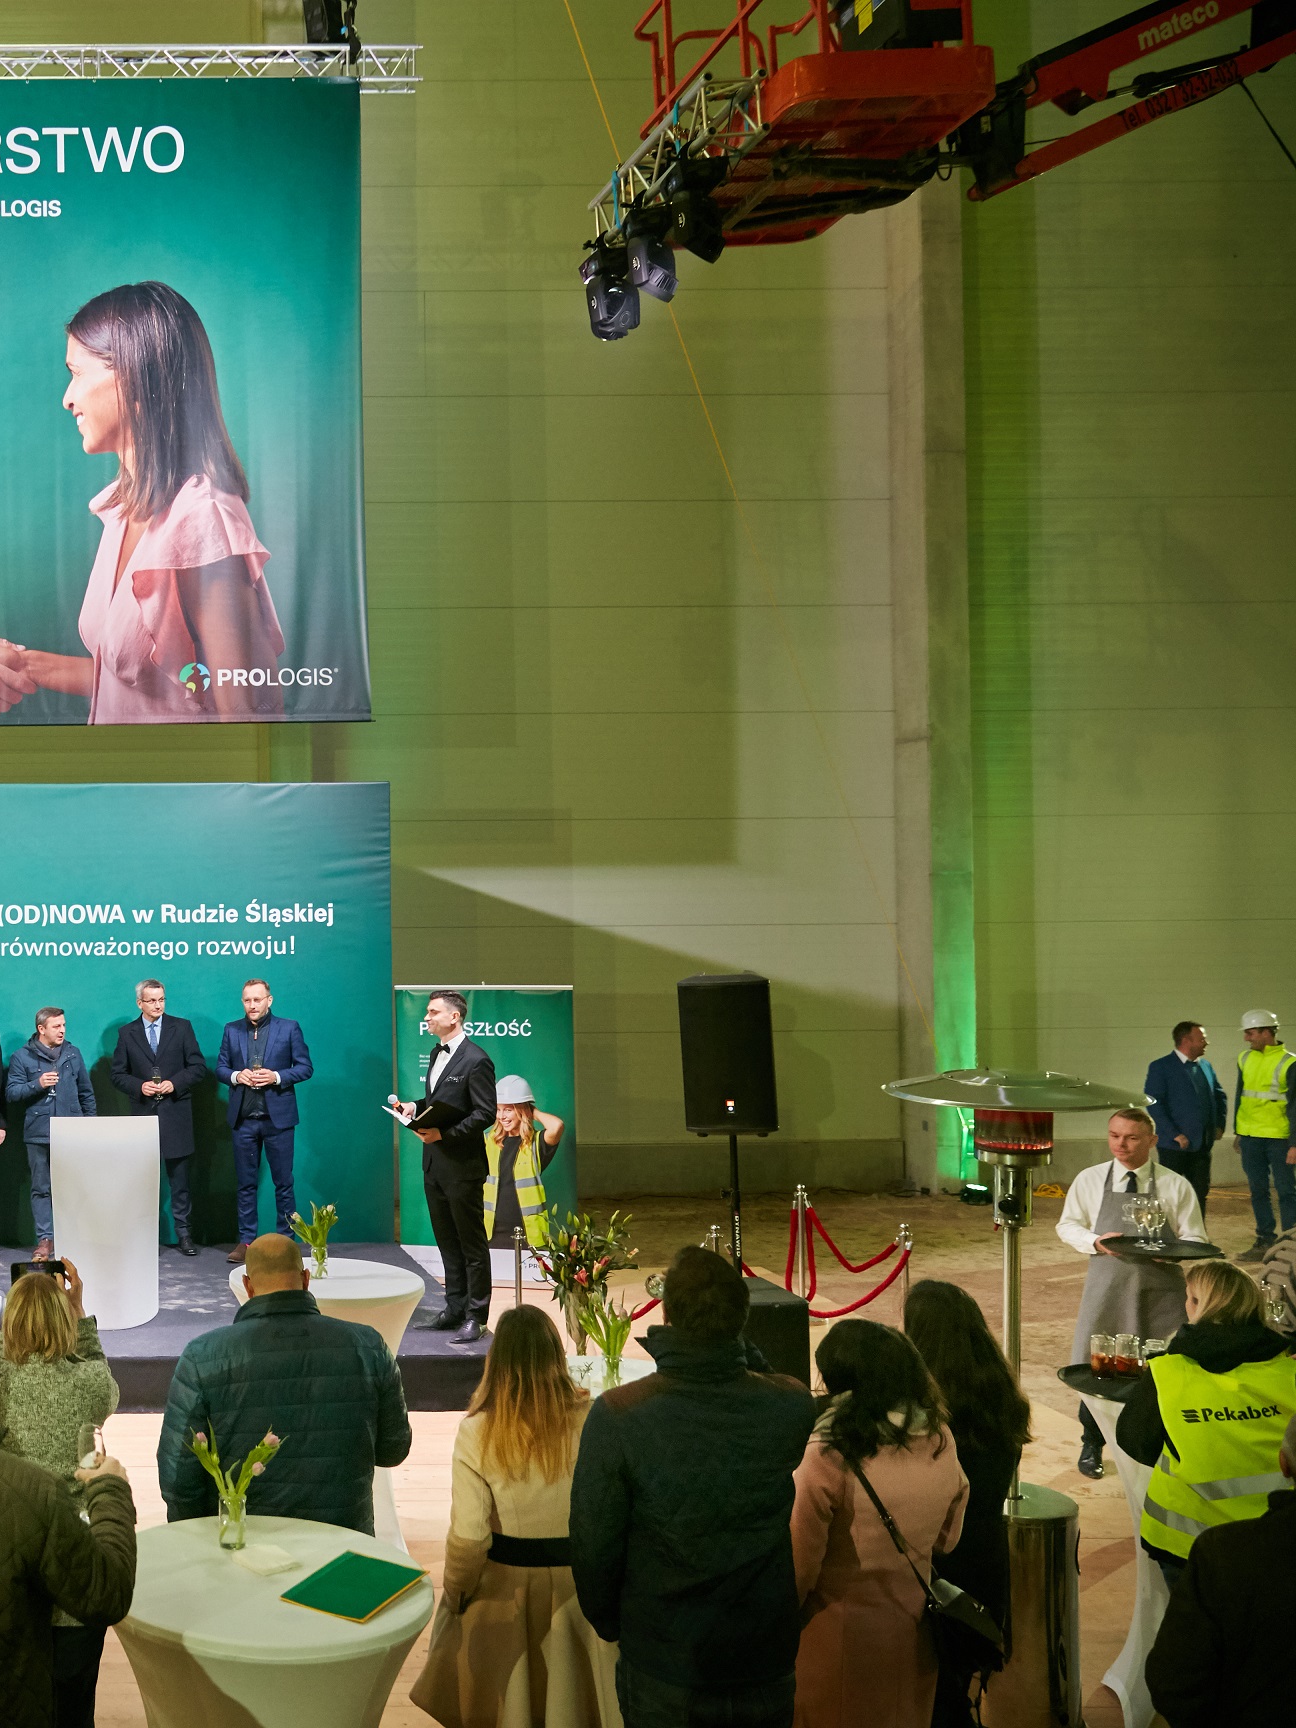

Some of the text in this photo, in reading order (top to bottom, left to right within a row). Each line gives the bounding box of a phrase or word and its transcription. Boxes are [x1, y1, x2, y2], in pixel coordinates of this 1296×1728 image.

[1137, 1, 1219, 50] mateco
[1117, 107, 1146, 130] Tel.
[1145, 93, 1173, 119] 032
[132, 909, 154, 923] w
[161, 903, 239, 924] Rudzie
[245, 898, 334, 928] Śląskiej
[197, 935, 295, 960] rozwoju!
[419, 1019, 532, 1037] PSZŁOŚĆ
[1201, 1405, 1283, 1422] Pekabex
